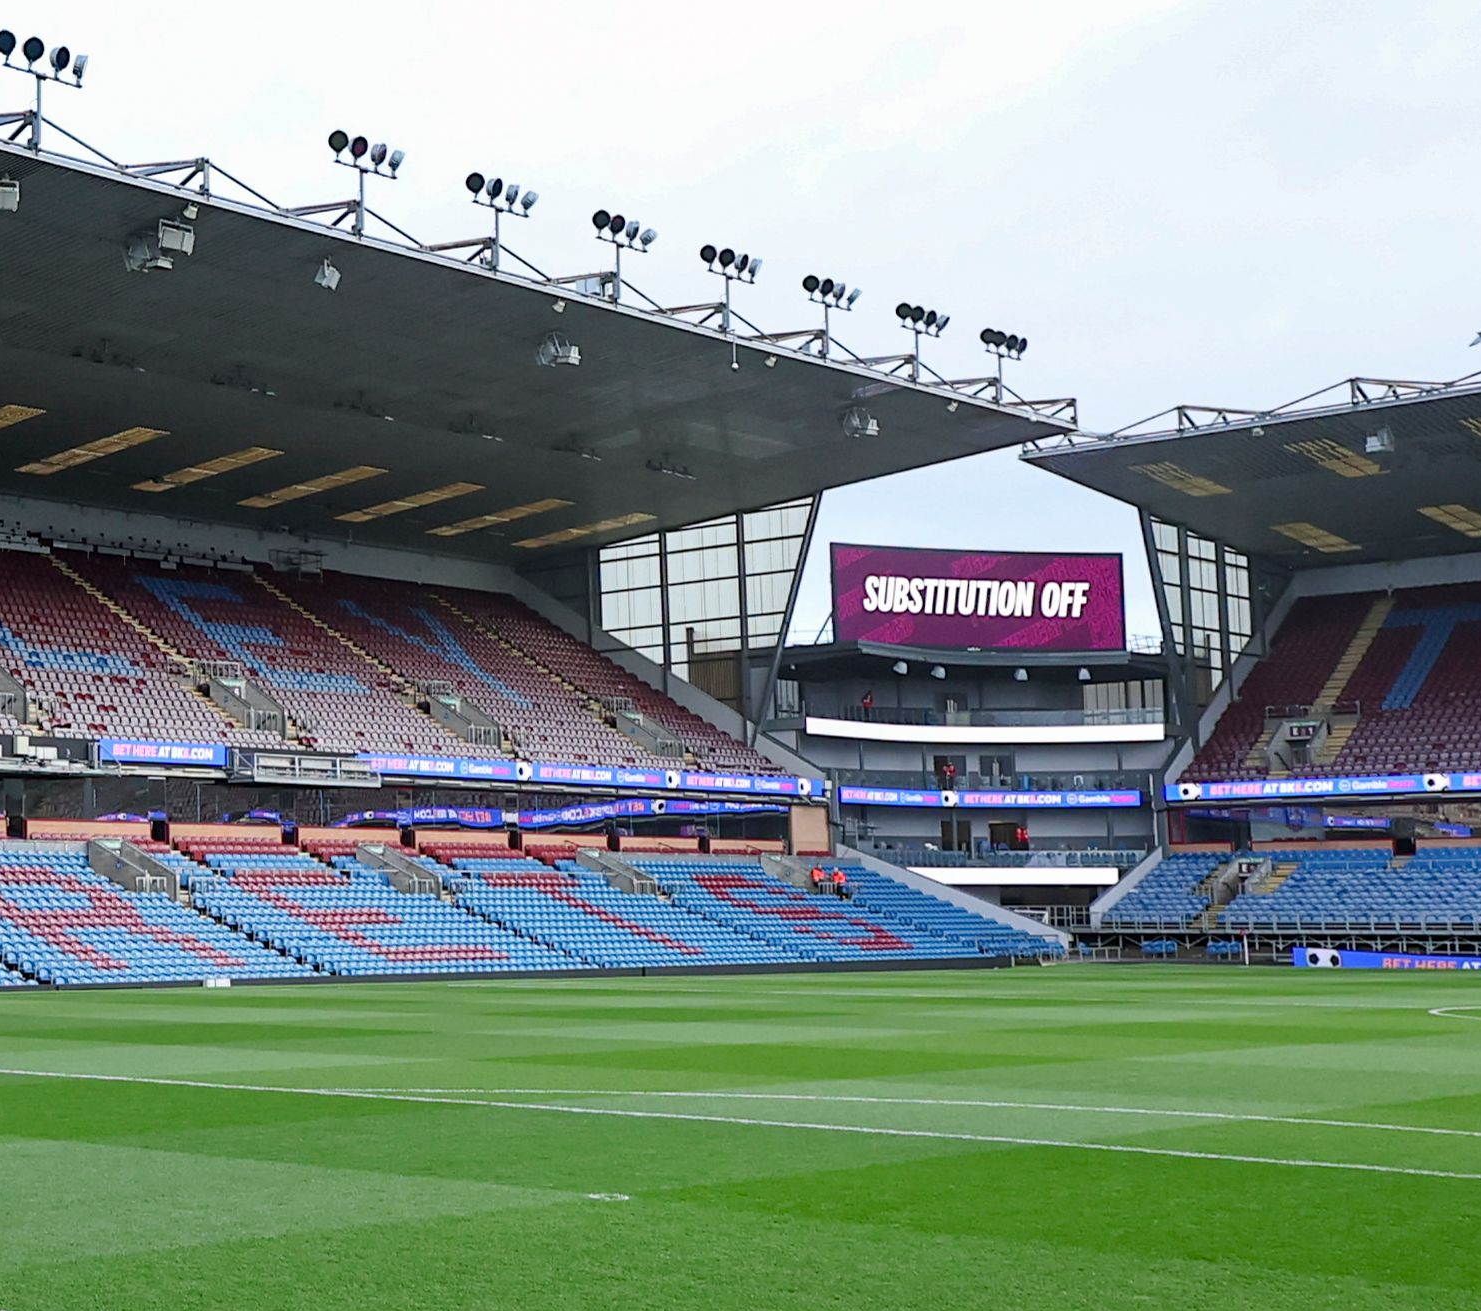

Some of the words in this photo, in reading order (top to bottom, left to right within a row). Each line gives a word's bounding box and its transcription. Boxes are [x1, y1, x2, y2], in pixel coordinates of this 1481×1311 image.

[863, 575, 1035, 617] SUBSTITUTION
[1040, 582, 1090, 618] OFF
[112, 743, 131, 756] BET
[132, 744, 157, 757] HERE
[158, 746, 171, 758] AT
[1209, 784, 1231, 796] BET
[1231, 783, 1262, 795] HERE
[1263, 783, 1279, 795] AT
[964, 793, 985, 804] BET
[985, 793, 1004, 804] HERE
[1004, 794, 1018, 805] AT
